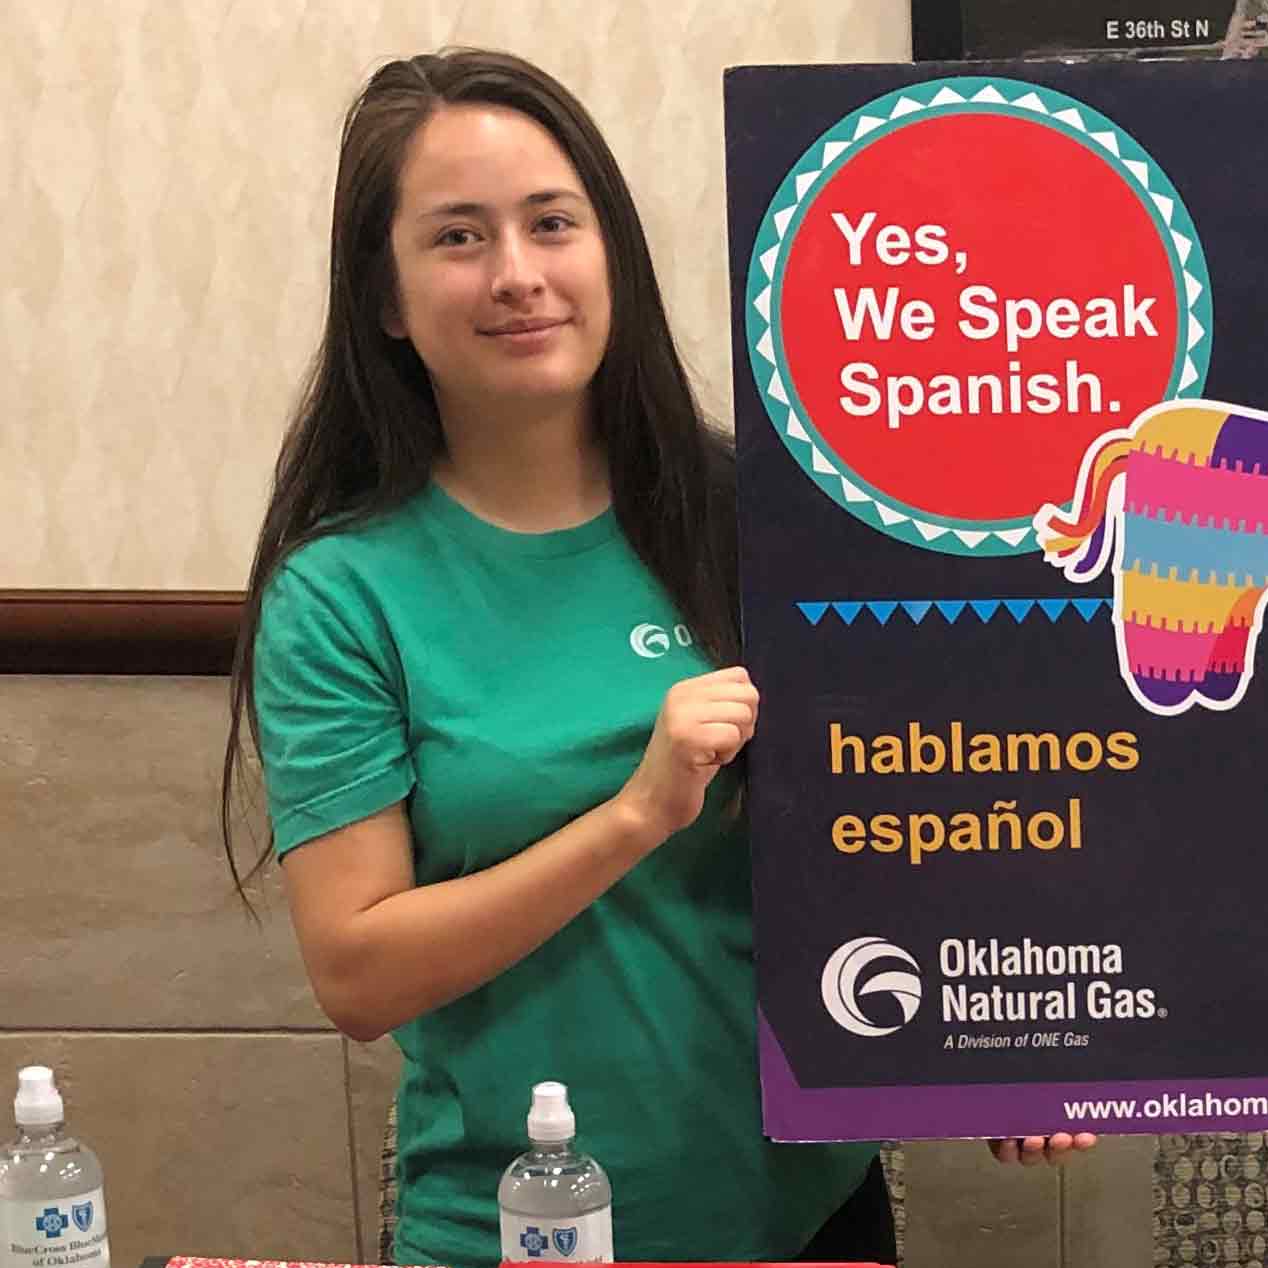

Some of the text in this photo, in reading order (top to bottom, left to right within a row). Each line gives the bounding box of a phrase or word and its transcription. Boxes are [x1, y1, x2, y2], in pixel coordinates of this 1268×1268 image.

[1106, 19, 1209, 39] E 36th St N
[831, 212, 967, 274] Yes,
[833, 284, 1158, 353] We Speak
[839, 360, 1121, 428] Spanish.
[830, 721, 1140, 774] hablamos
[831, 798, 1081, 865] español
[939, 937, 1123, 978] Oklahoma
[941, 981, 1076, 1022] Natural
[944, 1031, 1090, 1049] A Division of ONE Gas
